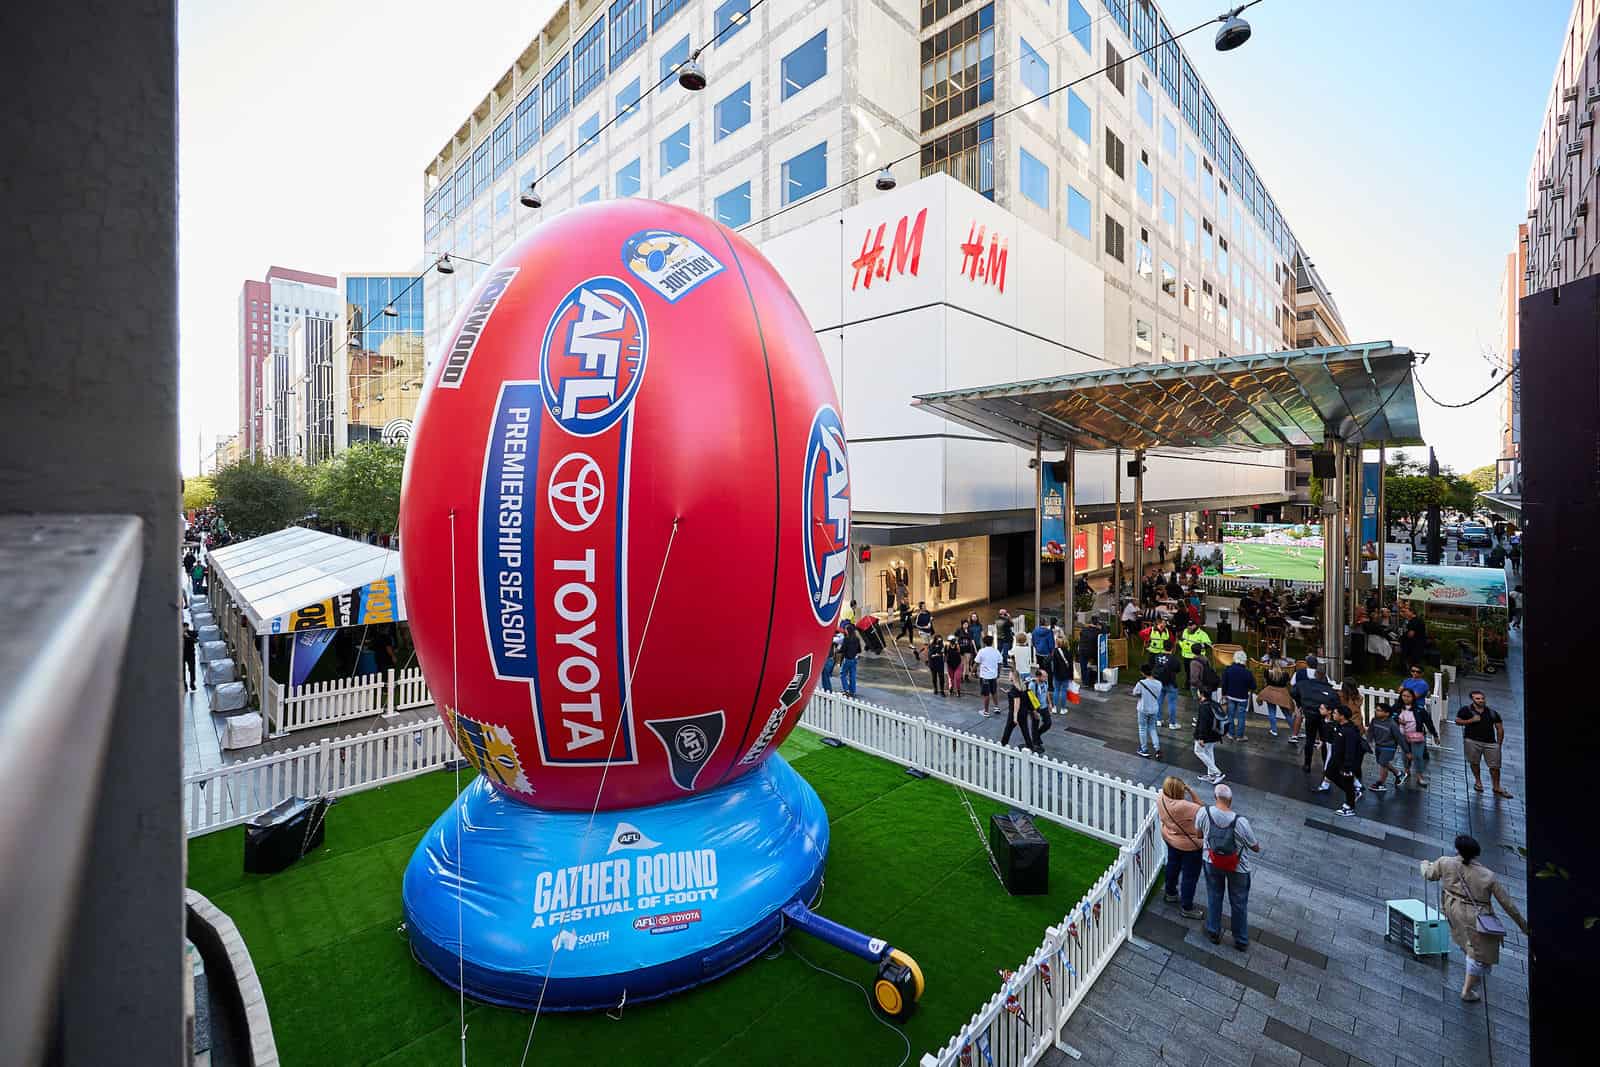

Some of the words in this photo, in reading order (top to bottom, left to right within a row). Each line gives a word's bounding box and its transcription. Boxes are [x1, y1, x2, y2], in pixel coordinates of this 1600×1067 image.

[659, 255, 716, 294] ADELAIDE
[851, 207, 928, 291] H&M
[960, 218, 1009, 294] H&M
[557, 287, 627, 421] AFL
[498, 407, 531, 569] PREMIERSHIP
[819, 423, 850, 608] AFL
[1074, 544, 1086, 560] ale
[499, 570, 528, 659] SEASON
[553, 549, 605, 752] TOYOTA
[680, 731, 702, 760] AFL
[618, 833, 640, 843] AFL
[531, 916, 545, 929] A
[549, 900, 634, 925] FESTIVAL
[637, 896, 661, 910] OF
[664, 887, 719, 906] FOOTY
[534, 858, 630, 913] GATHER
[636, 848, 719, 899] ROUND
[578, 931, 610, 944] SOUTH
[635, 917, 655, 928] AFL
[671, 911, 700, 923] TOYOTA
